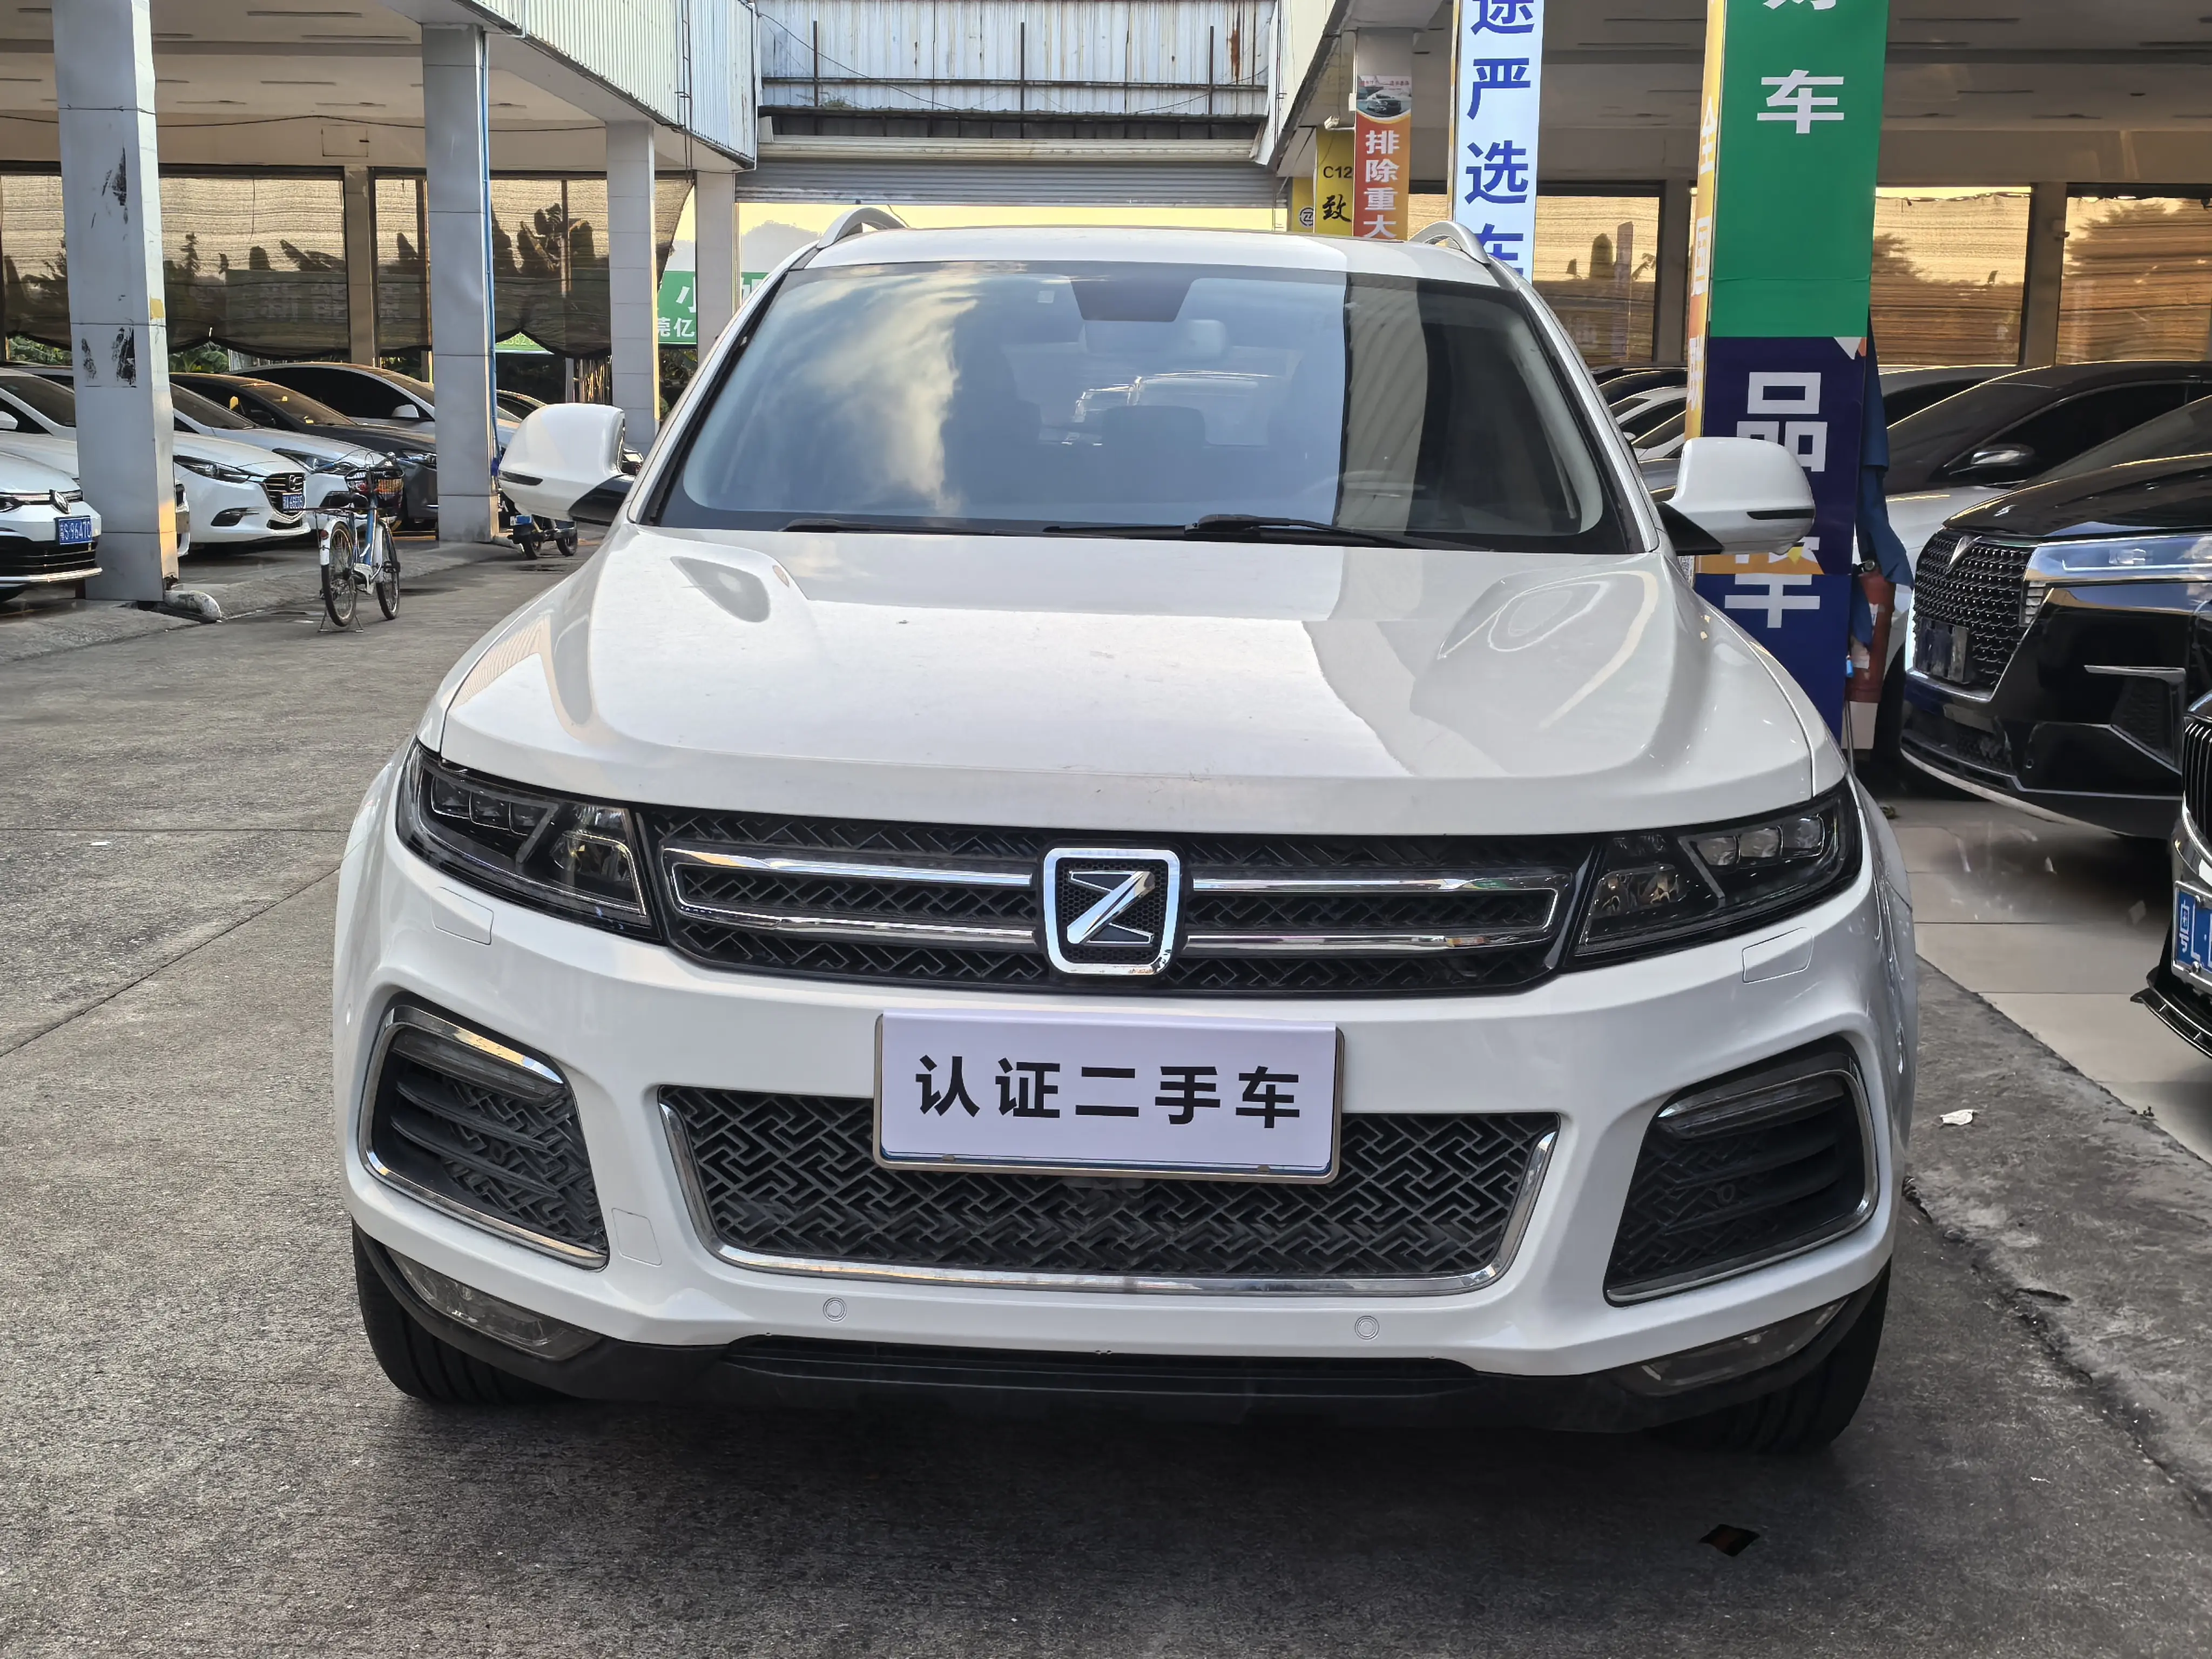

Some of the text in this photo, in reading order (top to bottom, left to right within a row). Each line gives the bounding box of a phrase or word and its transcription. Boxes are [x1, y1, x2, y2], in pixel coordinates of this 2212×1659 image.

[1363, 130, 1400, 238] 排除重大
[915, 1055, 1300, 1129] 认证二手车
